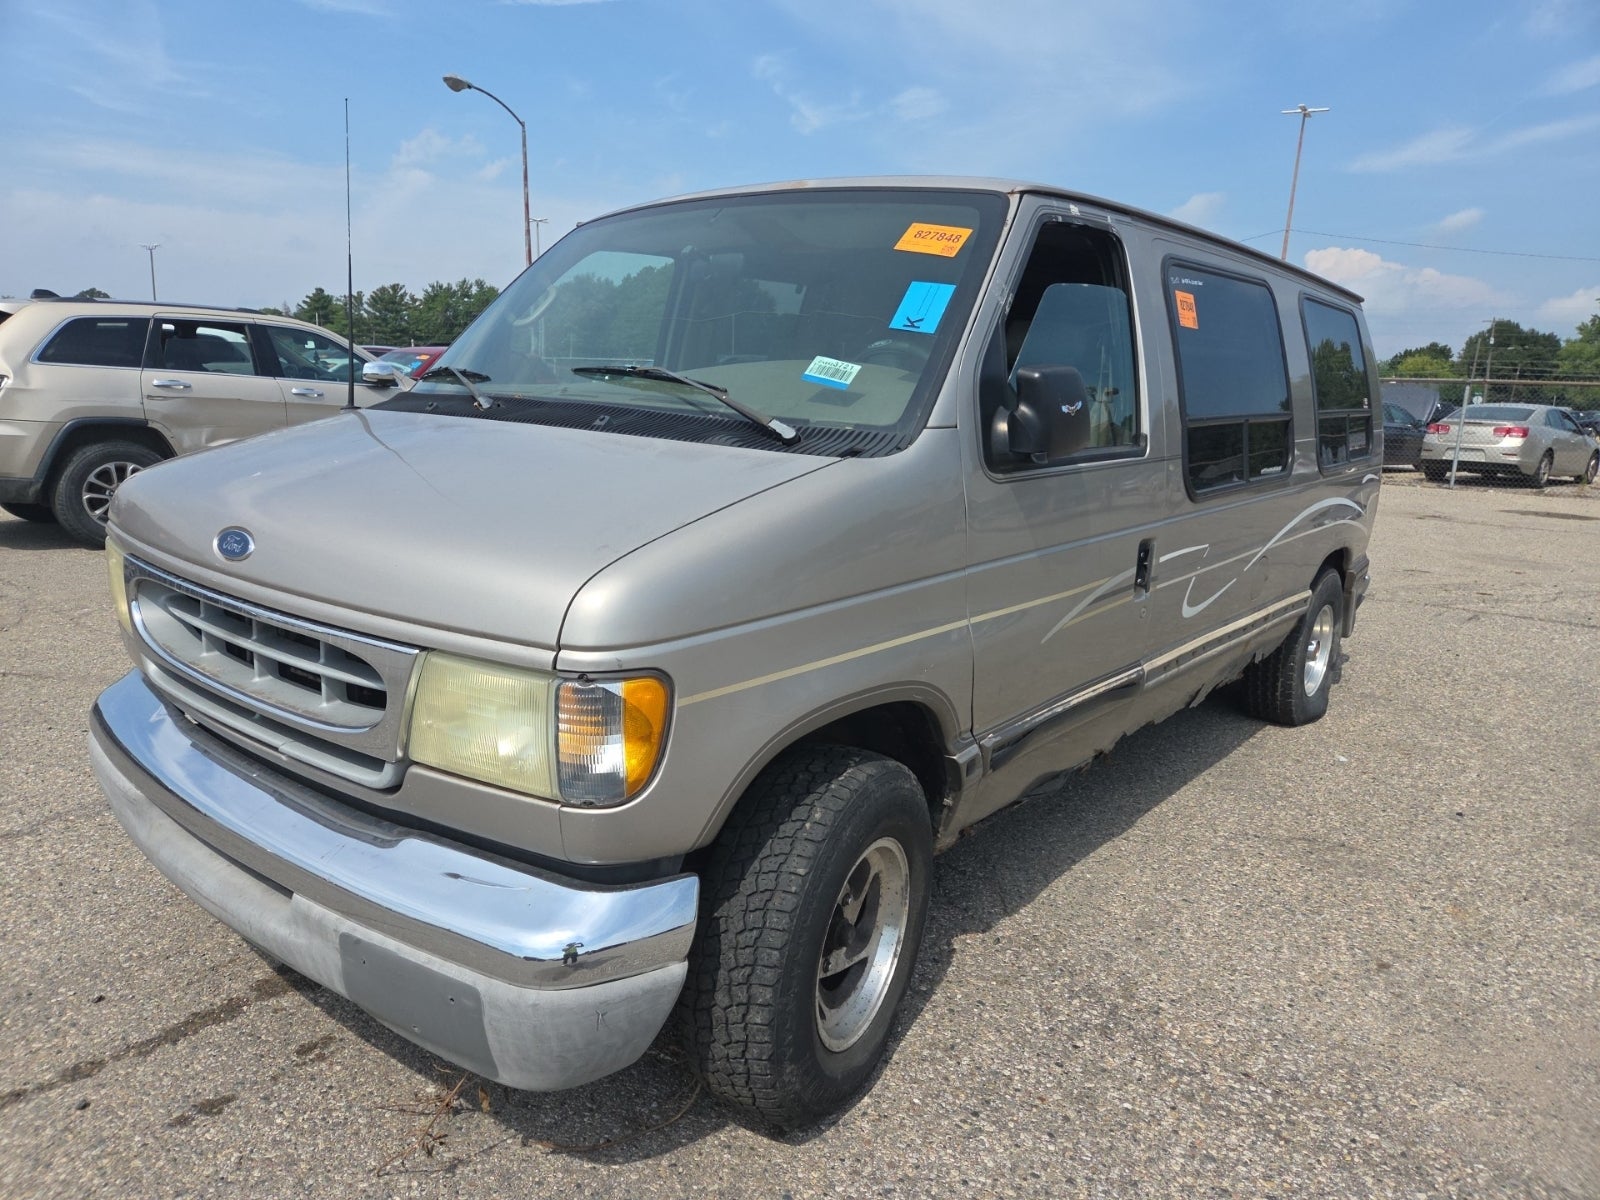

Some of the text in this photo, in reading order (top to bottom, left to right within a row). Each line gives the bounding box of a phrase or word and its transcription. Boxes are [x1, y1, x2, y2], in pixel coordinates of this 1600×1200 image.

[913, 230, 963, 244] 827848
[902, 316, 925, 329] K
[222, 534, 244, 553] Ford
